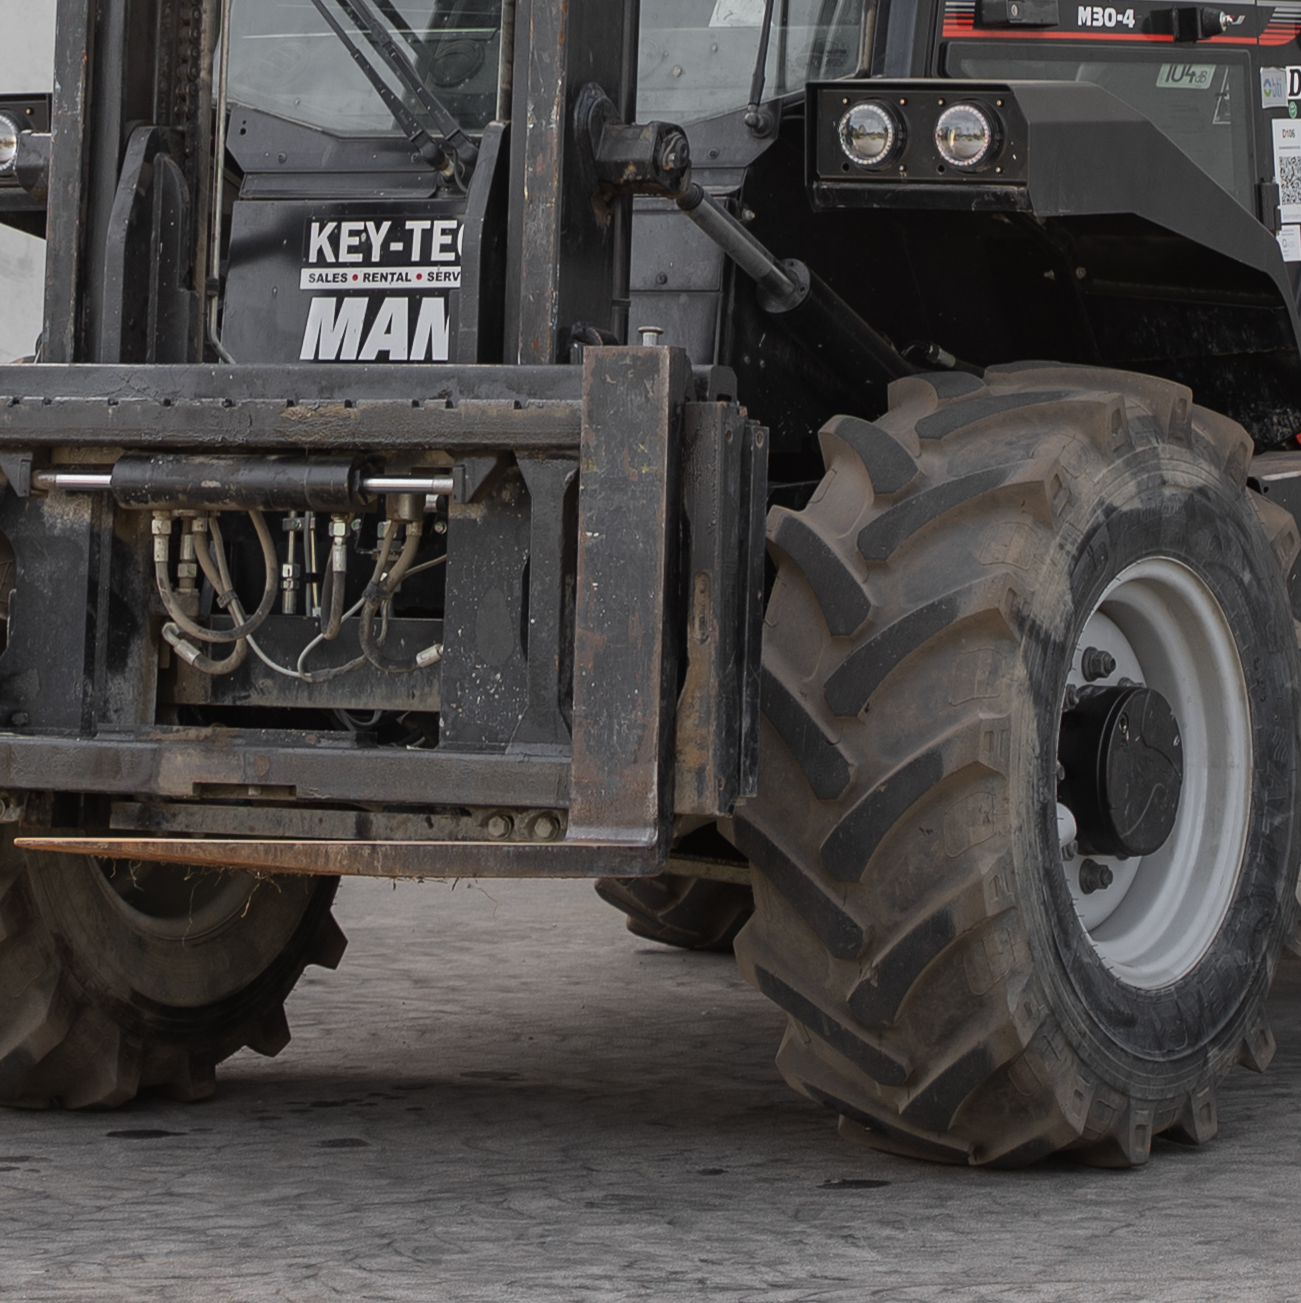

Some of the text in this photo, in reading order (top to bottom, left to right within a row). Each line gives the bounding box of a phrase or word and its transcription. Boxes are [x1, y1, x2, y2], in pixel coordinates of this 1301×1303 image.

[1077, 6, 1135, 28] M30-4
[308, 220, 464, 263] KEY-TE
[308, 272, 348, 283] SALES
[362, 272, 412, 283] RENTAL
